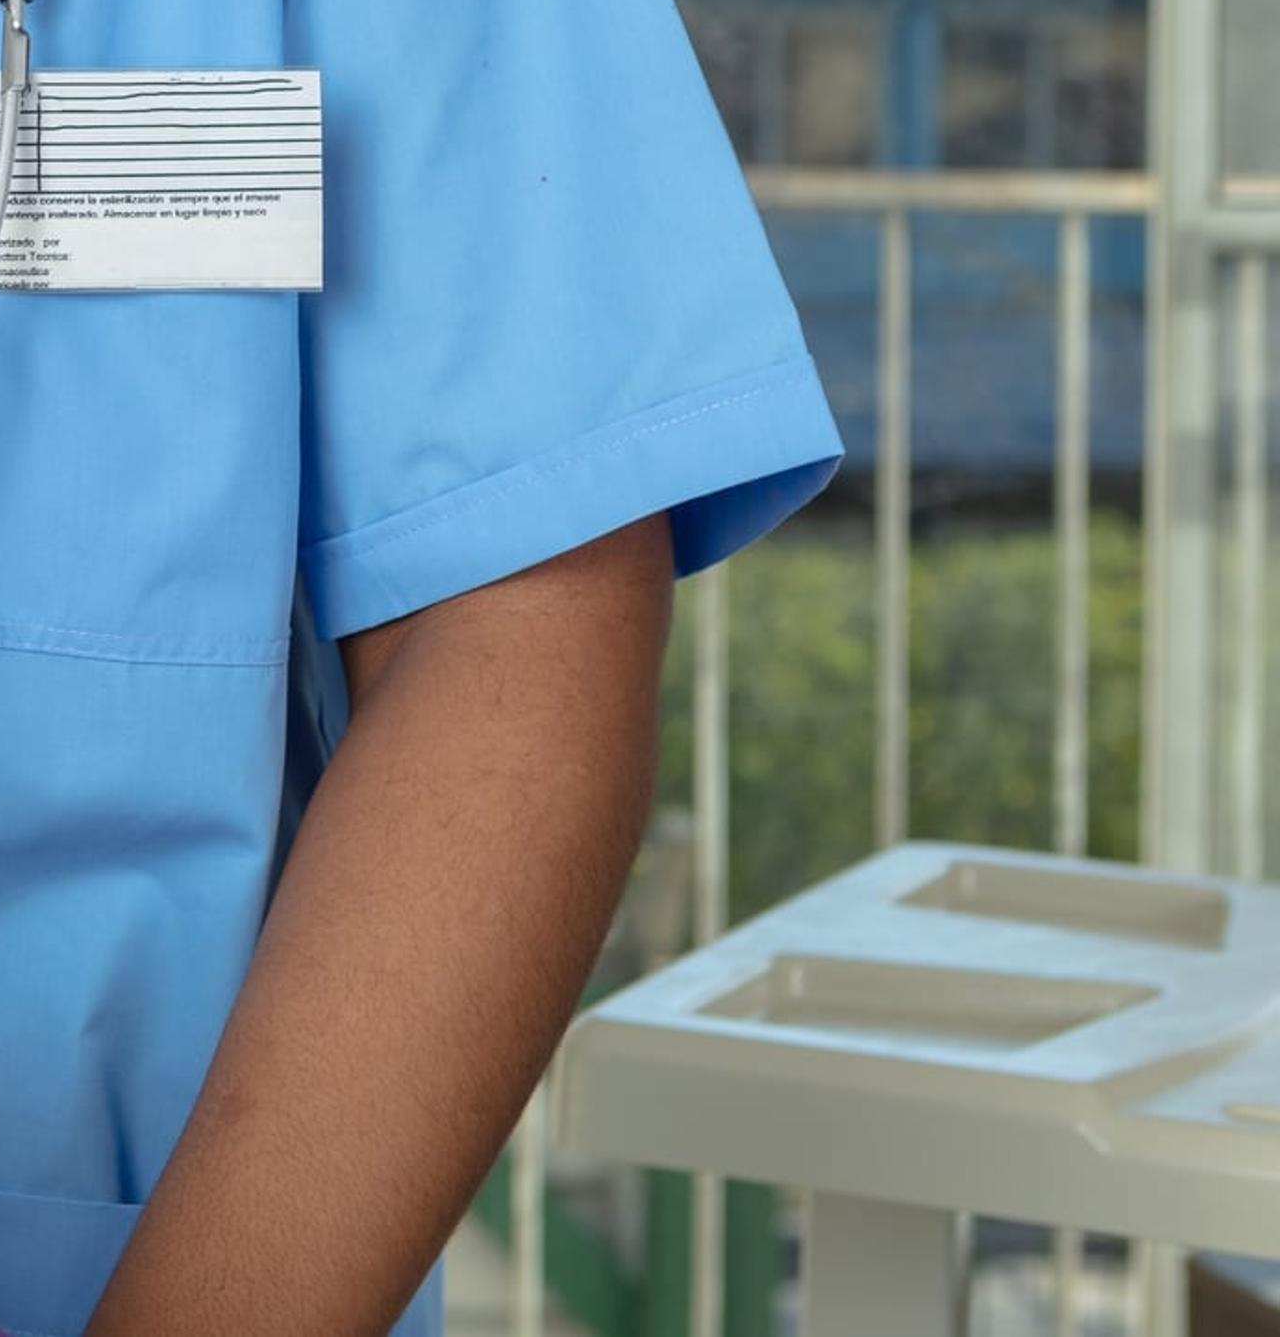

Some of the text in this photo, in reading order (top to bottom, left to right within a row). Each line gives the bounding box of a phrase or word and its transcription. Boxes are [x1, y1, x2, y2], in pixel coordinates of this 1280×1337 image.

[39, 197, 86, 205] conserva
[212, 195, 231, 205] que
[4, 211, 45, 222] antenga
[175, 208, 200, 220] lugar
